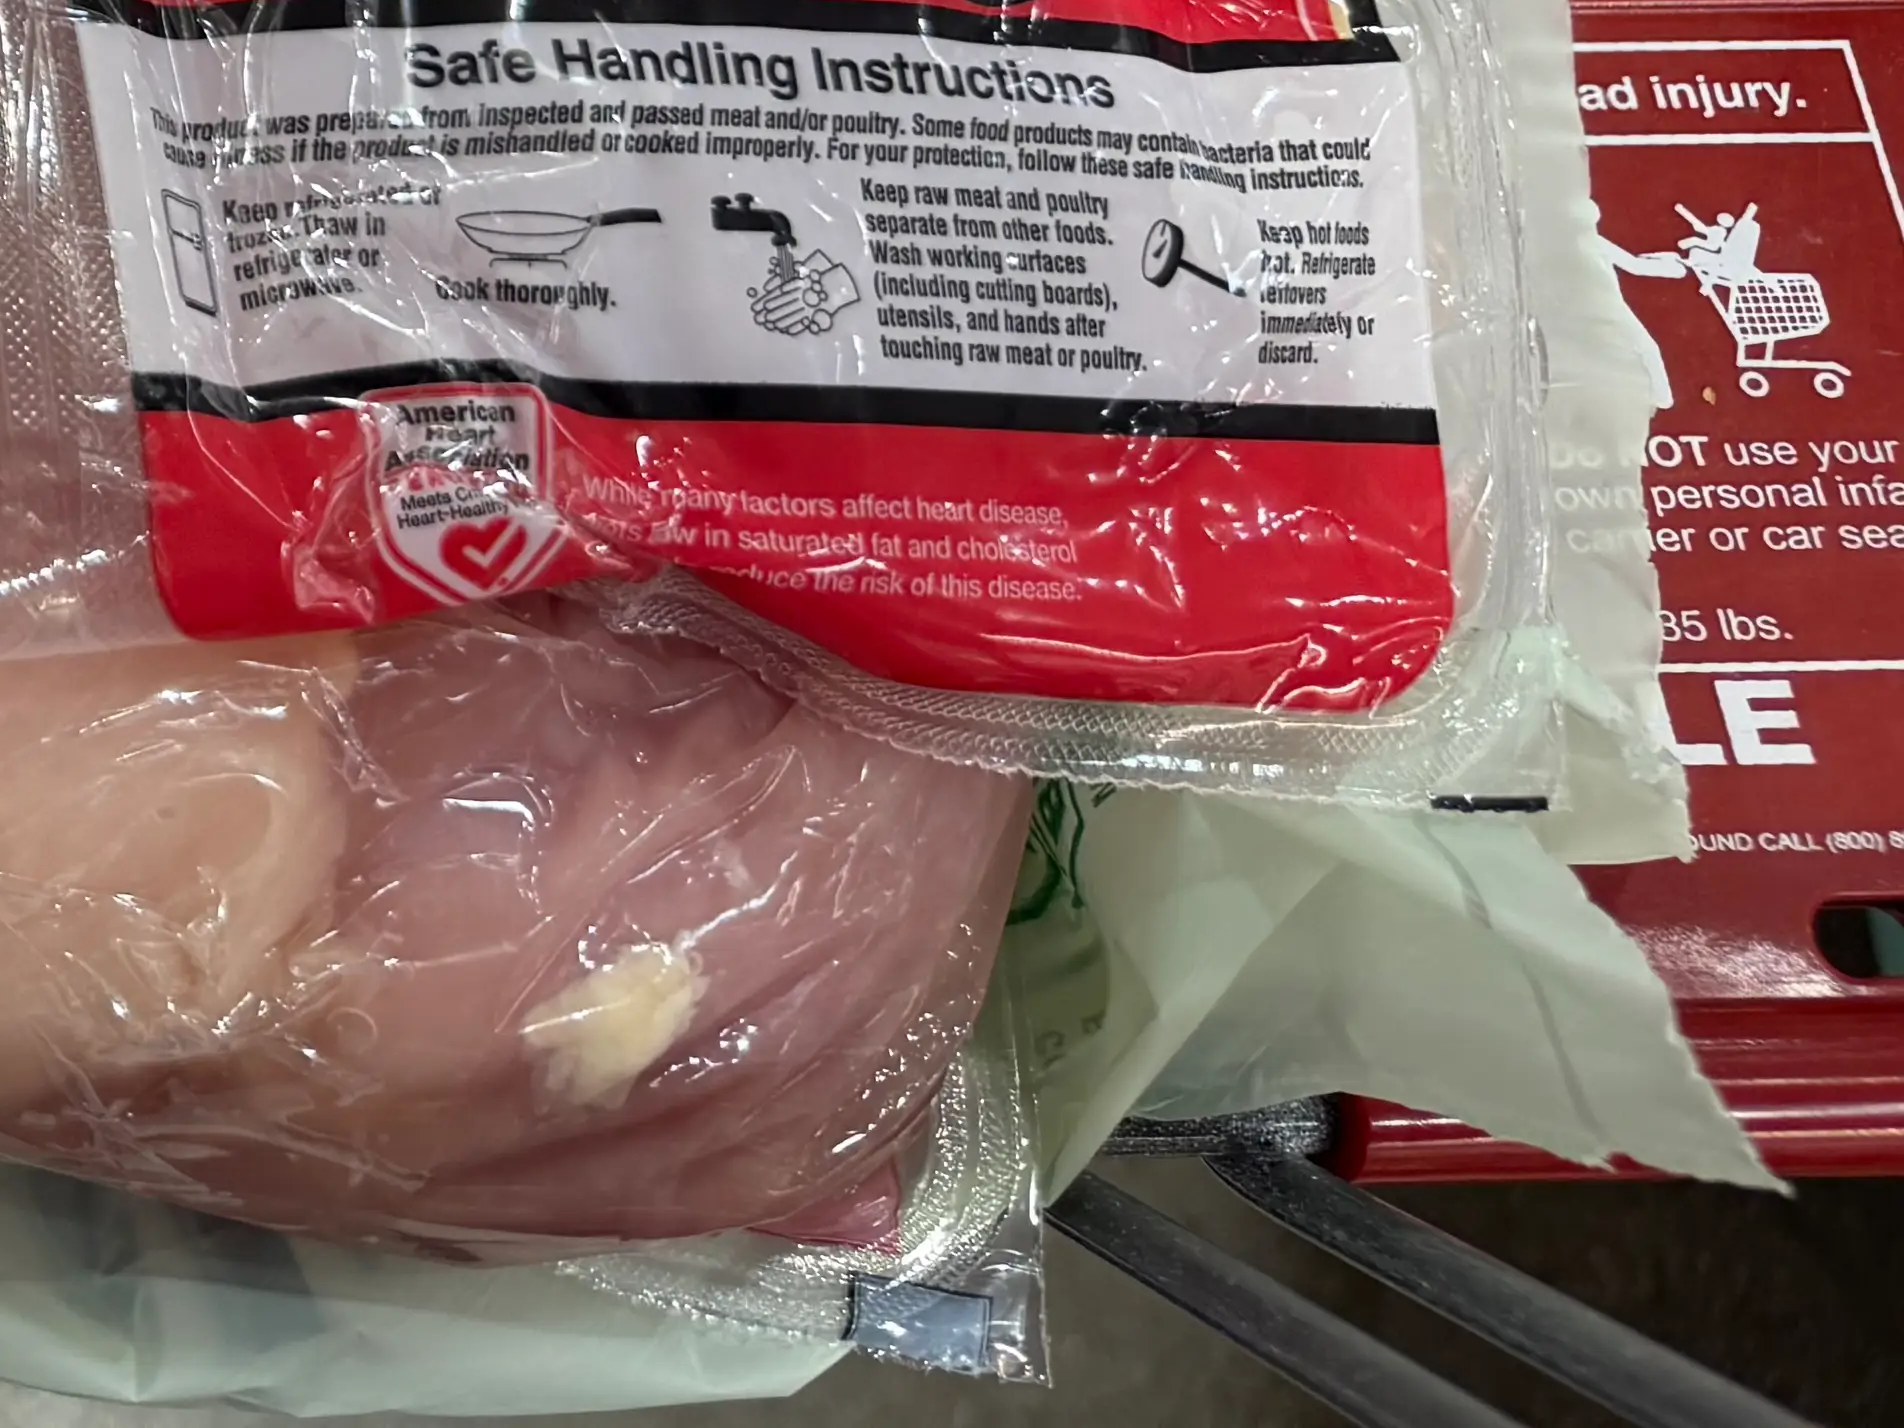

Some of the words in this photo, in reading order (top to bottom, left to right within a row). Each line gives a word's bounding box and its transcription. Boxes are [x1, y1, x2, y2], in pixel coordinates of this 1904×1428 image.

[407, 41, 538, 89] Safe
[557, 37, 799, 99] Handling
[811, 43, 1117, 110] Instructions
[1578, 76, 1638, 110] ad
[1649, 75, 1808, 118] injury.
[1724, 441, 1798, 467] use
[1808, 438, 1896, 473] your
[1650, 476, 1827, 516] personal
[1835, 474, 1904, 507] infa
[1710, 527, 1749, 551] or
[1763, 525, 1825, 551] car
[1838, 524, 1904, 551] sea
[1716, 608, 1794, 641] lbs.
[1758, 832, 1825, 852] CALL
[1825, 831, 1888, 854] (800)
